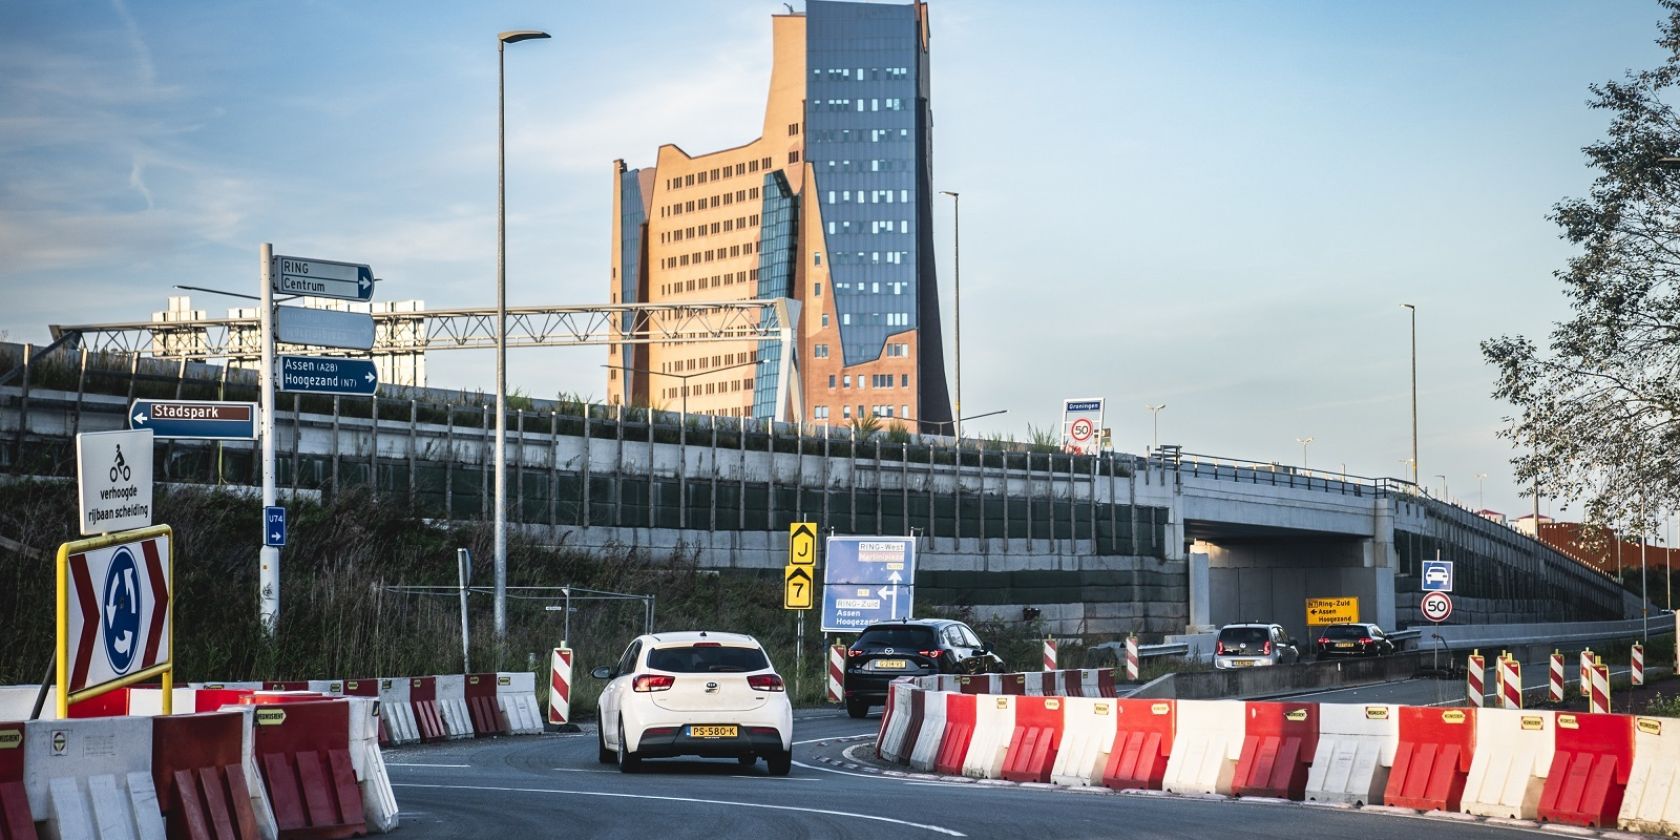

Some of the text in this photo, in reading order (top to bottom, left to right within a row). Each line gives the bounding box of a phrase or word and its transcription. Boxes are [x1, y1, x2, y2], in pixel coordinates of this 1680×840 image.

[284, 260, 309, 274] RING
[284, 277, 325, 292] Centrum
[285, 359, 338, 373] Assen (A28)
[285, 373, 357, 389] Hoogezand (N7)
[155, 405, 219, 420] Stadspark
[1075, 425, 1089, 435] 50
[100, 484, 138, 501] verhoogde
[89, 504, 149, 525] rijbaan scheiding
[269, 514, 283, 523] U74
[798, 542, 808, 557] J
[793, 583, 804, 597] 7
[1318, 600, 1350, 608] Ring-Zuid
[1427, 600, 1447, 612] 50
[836, 609, 861, 617] Assen
[1318, 616, 1352, 624] Hoogezand
[693, 727, 735, 736] PS-580-K
